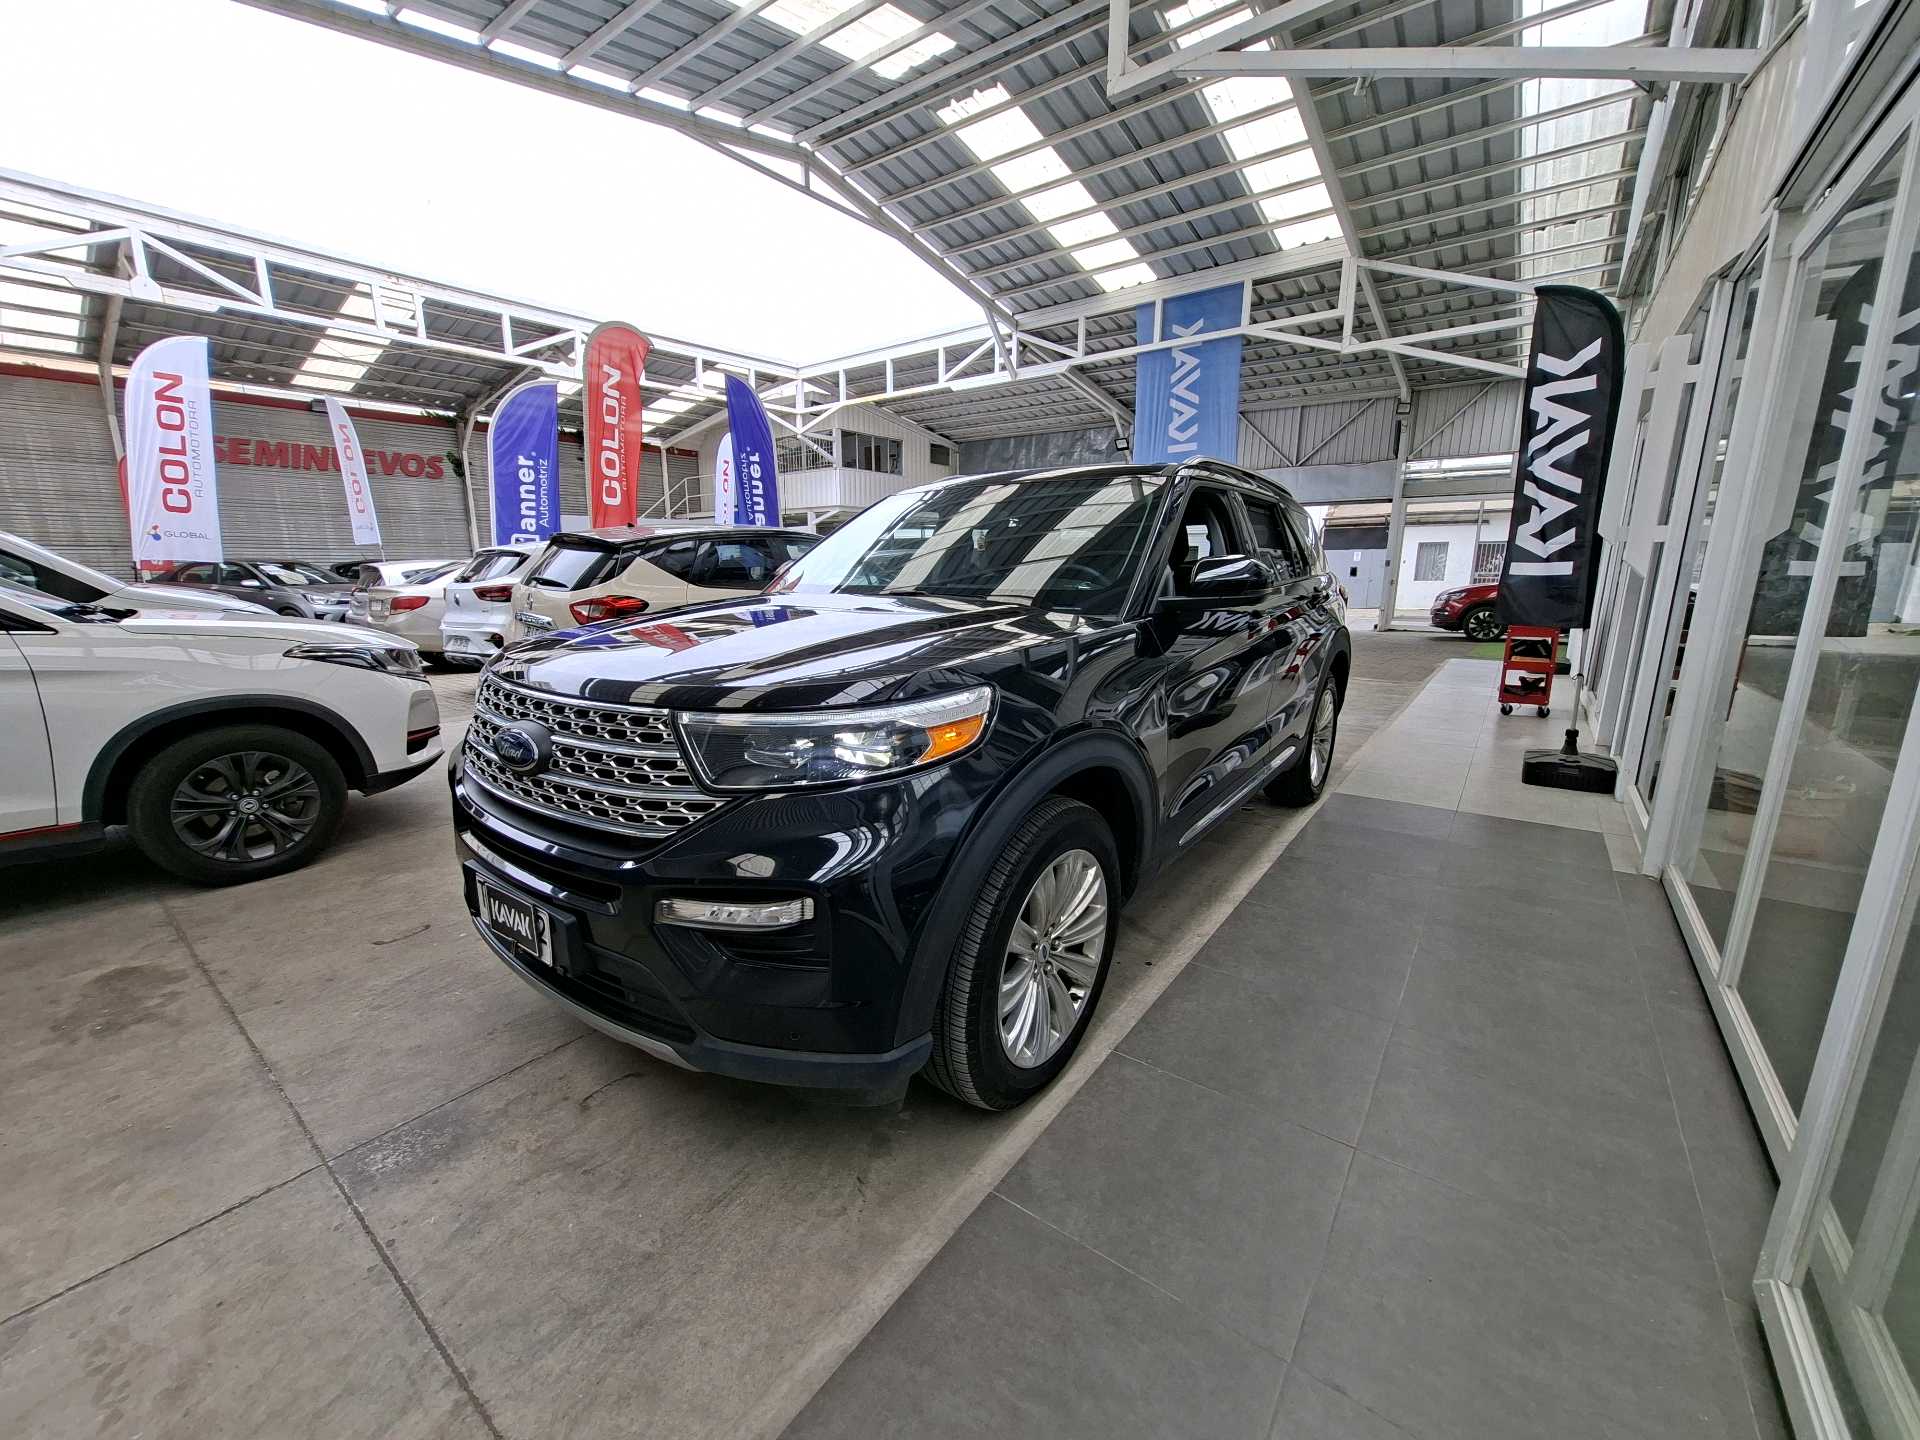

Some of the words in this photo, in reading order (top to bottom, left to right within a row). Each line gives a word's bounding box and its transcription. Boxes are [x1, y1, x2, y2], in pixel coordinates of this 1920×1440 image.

[152, 371, 193, 514] COLON
[600, 364, 622, 506] COLON
[1167, 317, 1205, 454] KAVAK
[188, 400, 206, 499] AUTOMOTORA
[537, 458, 550, 528] Automotriz
[1509, 336, 1602, 577] KAVAK
[163, 530, 210, 540] GLOBAL
[490, 897, 533, 940] KAVAK
